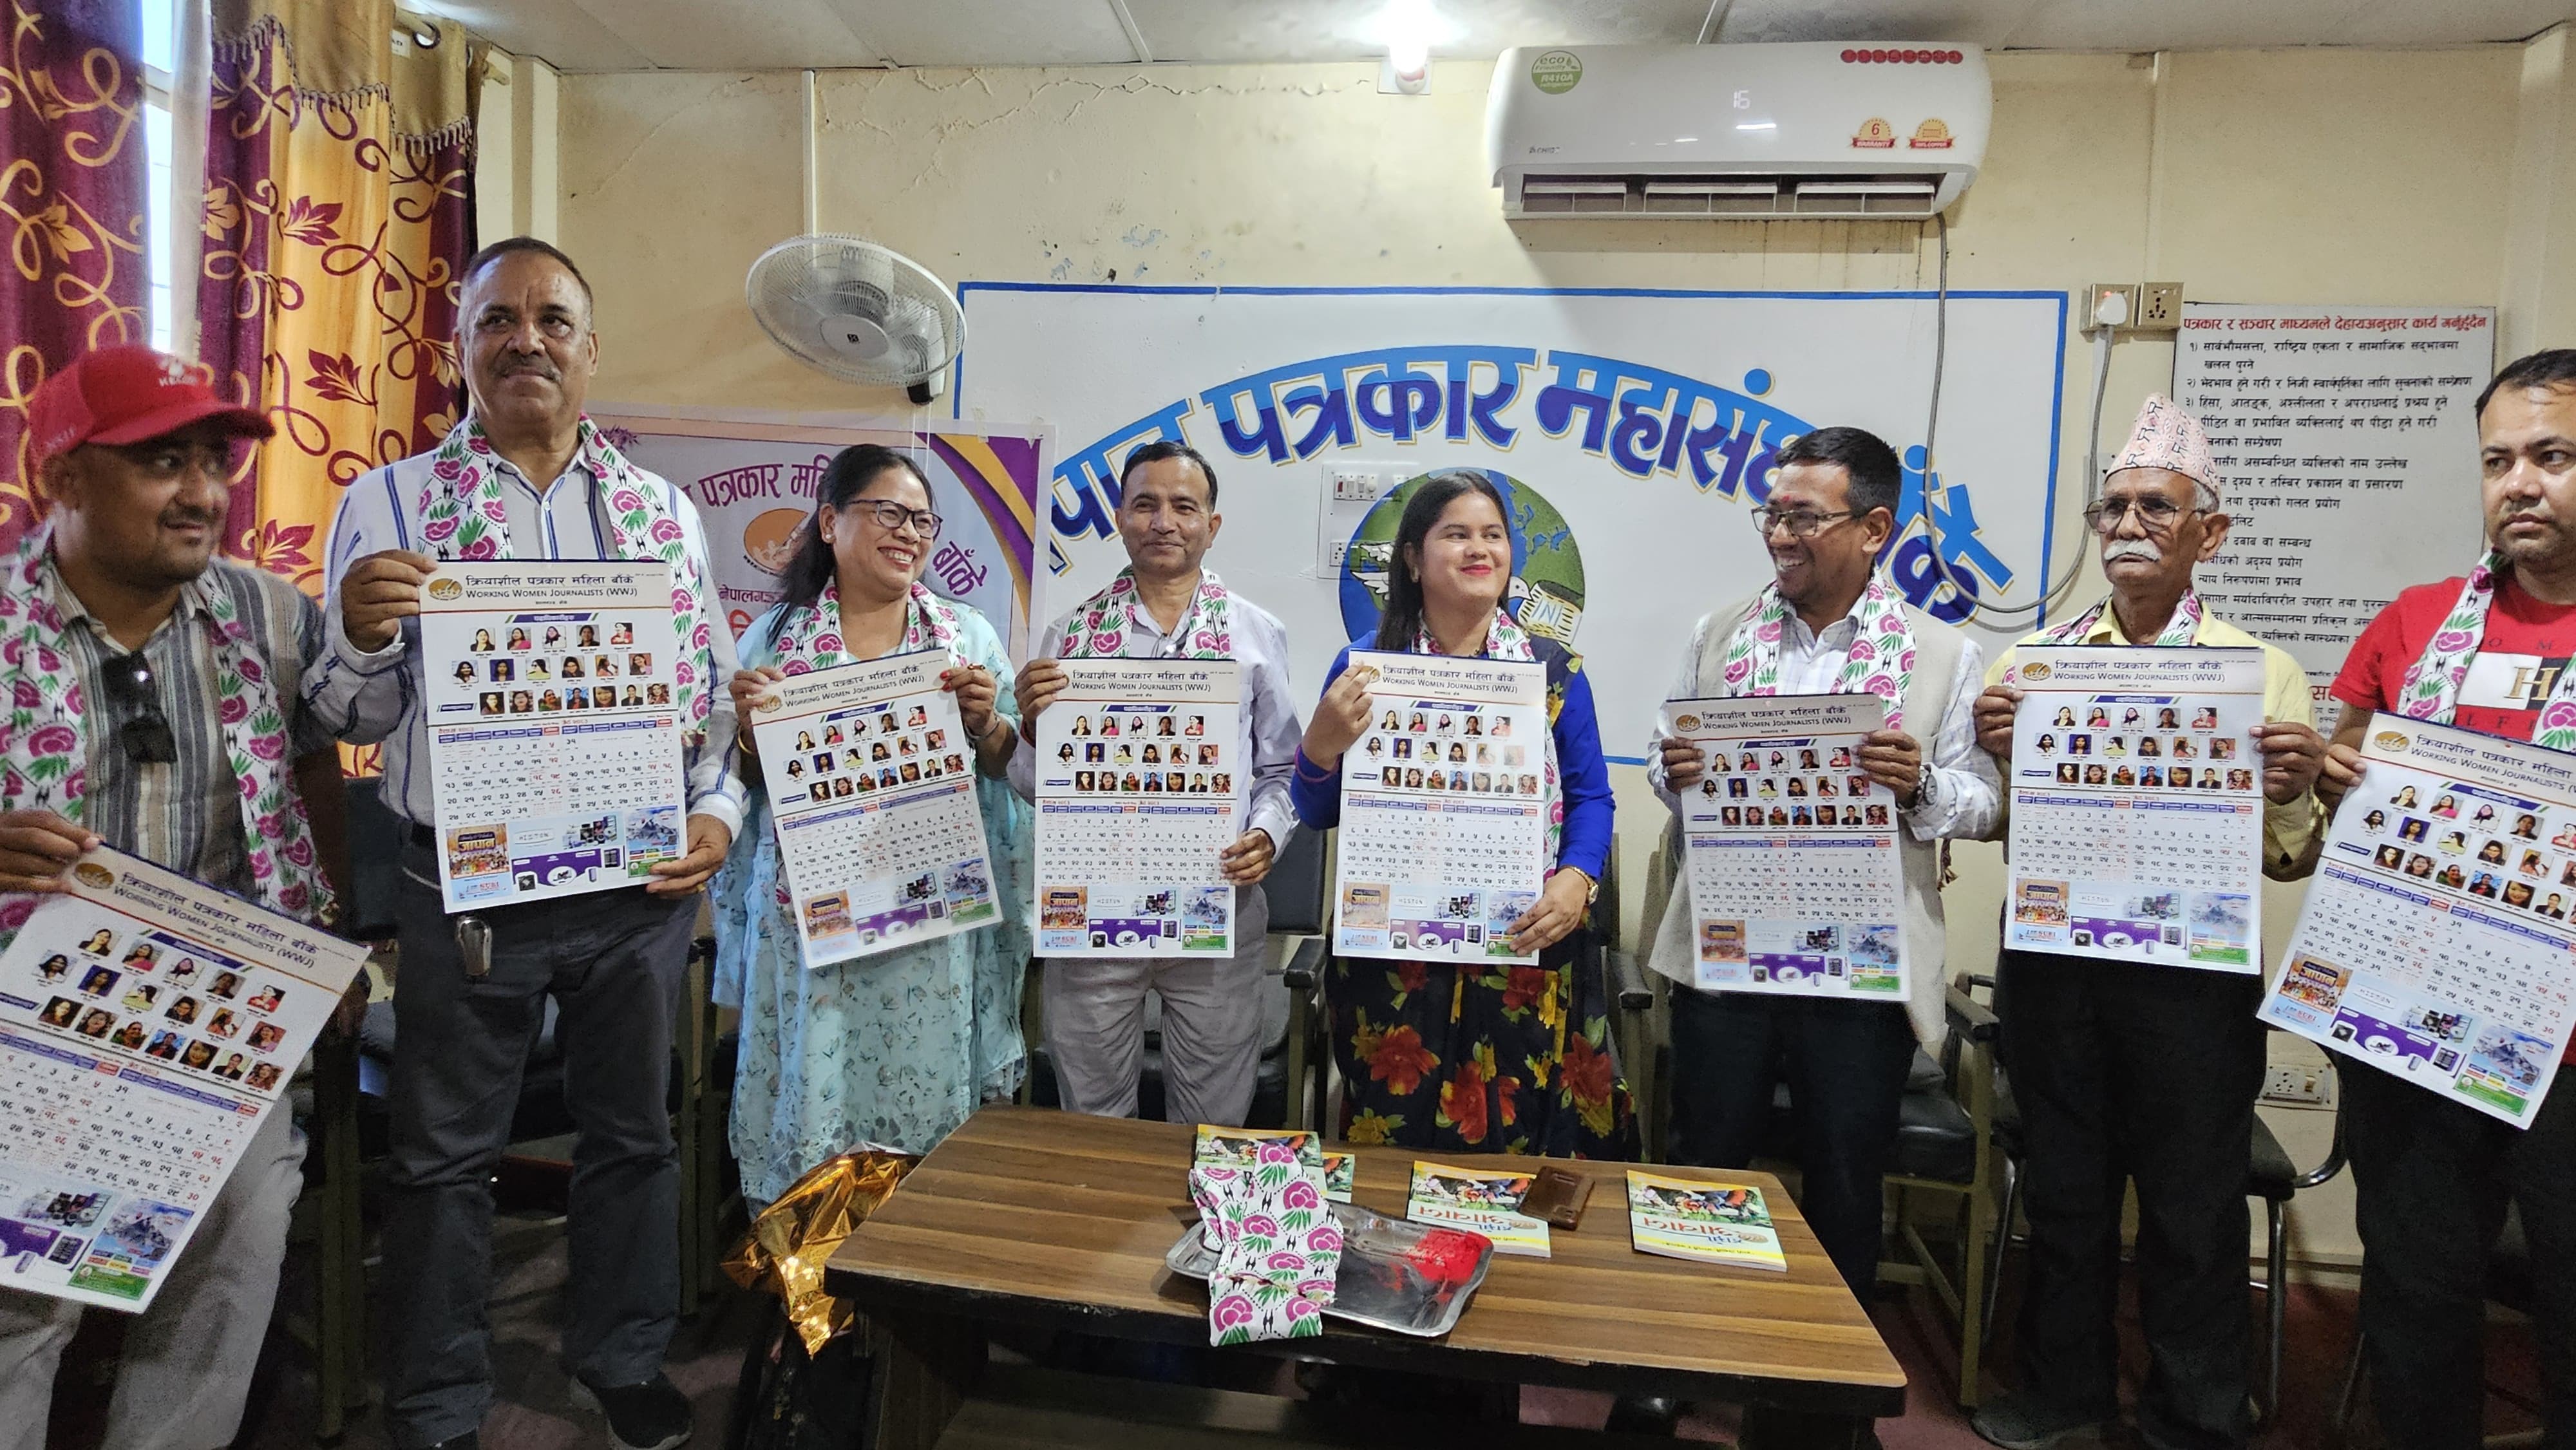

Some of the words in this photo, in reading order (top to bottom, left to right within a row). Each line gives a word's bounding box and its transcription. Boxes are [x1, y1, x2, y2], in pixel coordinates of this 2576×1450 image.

[1541, 73, 1573, 82] R410A
[1734, 90, 1750, 109] 16
[1871, 123, 1880, 135] 6
[2184, 318, 2222, 330] पत्रकार
[2226, 318, 2235, 330] र
[2313, 342, 2340, 353] एकता
[2346, 342, 2353, 351] र
[2359, 339, 2405, 350] सामाजिक
[2201, 376, 2233, 388] भेदभाव
[2275, 379, 2282, 389] र
[1199, 345, 1540, 467] पत्रकार
[2350, 458, 2369, 469] नाम
[697, 463, 784, 507] पत्रकार
[2286, 498, 2309, 508] गलत
[933, 541, 988, 596] बाँके
[466, 574, 521, 587] क्रियाशील
[527, 576, 565, 587] पत्रकार
[571, 574, 606, 585] महिला
[466, 589, 511, 599] WORKING
[513, 588, 547, 598] WOMEN
[549, 587, 604, 598] JOURNALISTS
[605, 587, 638, 598] (WWJ)
[2055, 659, 2107, 671] क्रियाशील
[2113, 661, 2151, 672] पत्रकार
[2158, 659, 2192, 671] महिला
[1121, 672, 1151, 681] पत्रकार
[1157, 670, 1185, 681] महिला
[1429, 669, 1461, 679] पत्रकार
[1465, 670, 1492, 682] महिला
[2054, 672, 2095, 681] WORKING
[2098, 672, 2132, 681] WOMEN
[2134, 672, 2189, 682] JOURNALISTS
[2192, 673, 2225, 683] (WWJ)
[1072, 682, 1106, 690] WORKING
[1138, 683, 1183, 692] JOURNALISTS
[1184, 683, 1211, 693] (WWJ)
[1382, 676, 1416, 686] WORKING
[1417, 679, 1445, 688] WOMEN
[1446, 681, 1490, 692] JOURNALISTS
[1491, 684, 1518, 694] (WWJ)
[822, 688, 851, 701] WOMEN
[1751, 709, 1785, 720] पत्रकार
[1790, 706, 1821, 718] महिला
[1702, 720, 1739, 730] WORKING
[1740, 719, 1770, 728] WOMEN
[1772, 717, 1821, 728] JOURNALISTS
[1821, 716, 1852, 726] (WWJ)
[2410, 746, 2458, 767] WORKING
[2460, 757, 2499, 776] WOMEN
[2500, 766, 2566, 791] JOURNALISTS
[2481, 750, 2526, 769] पत्रकार
[2532, 762, 2573, 780] महिला
